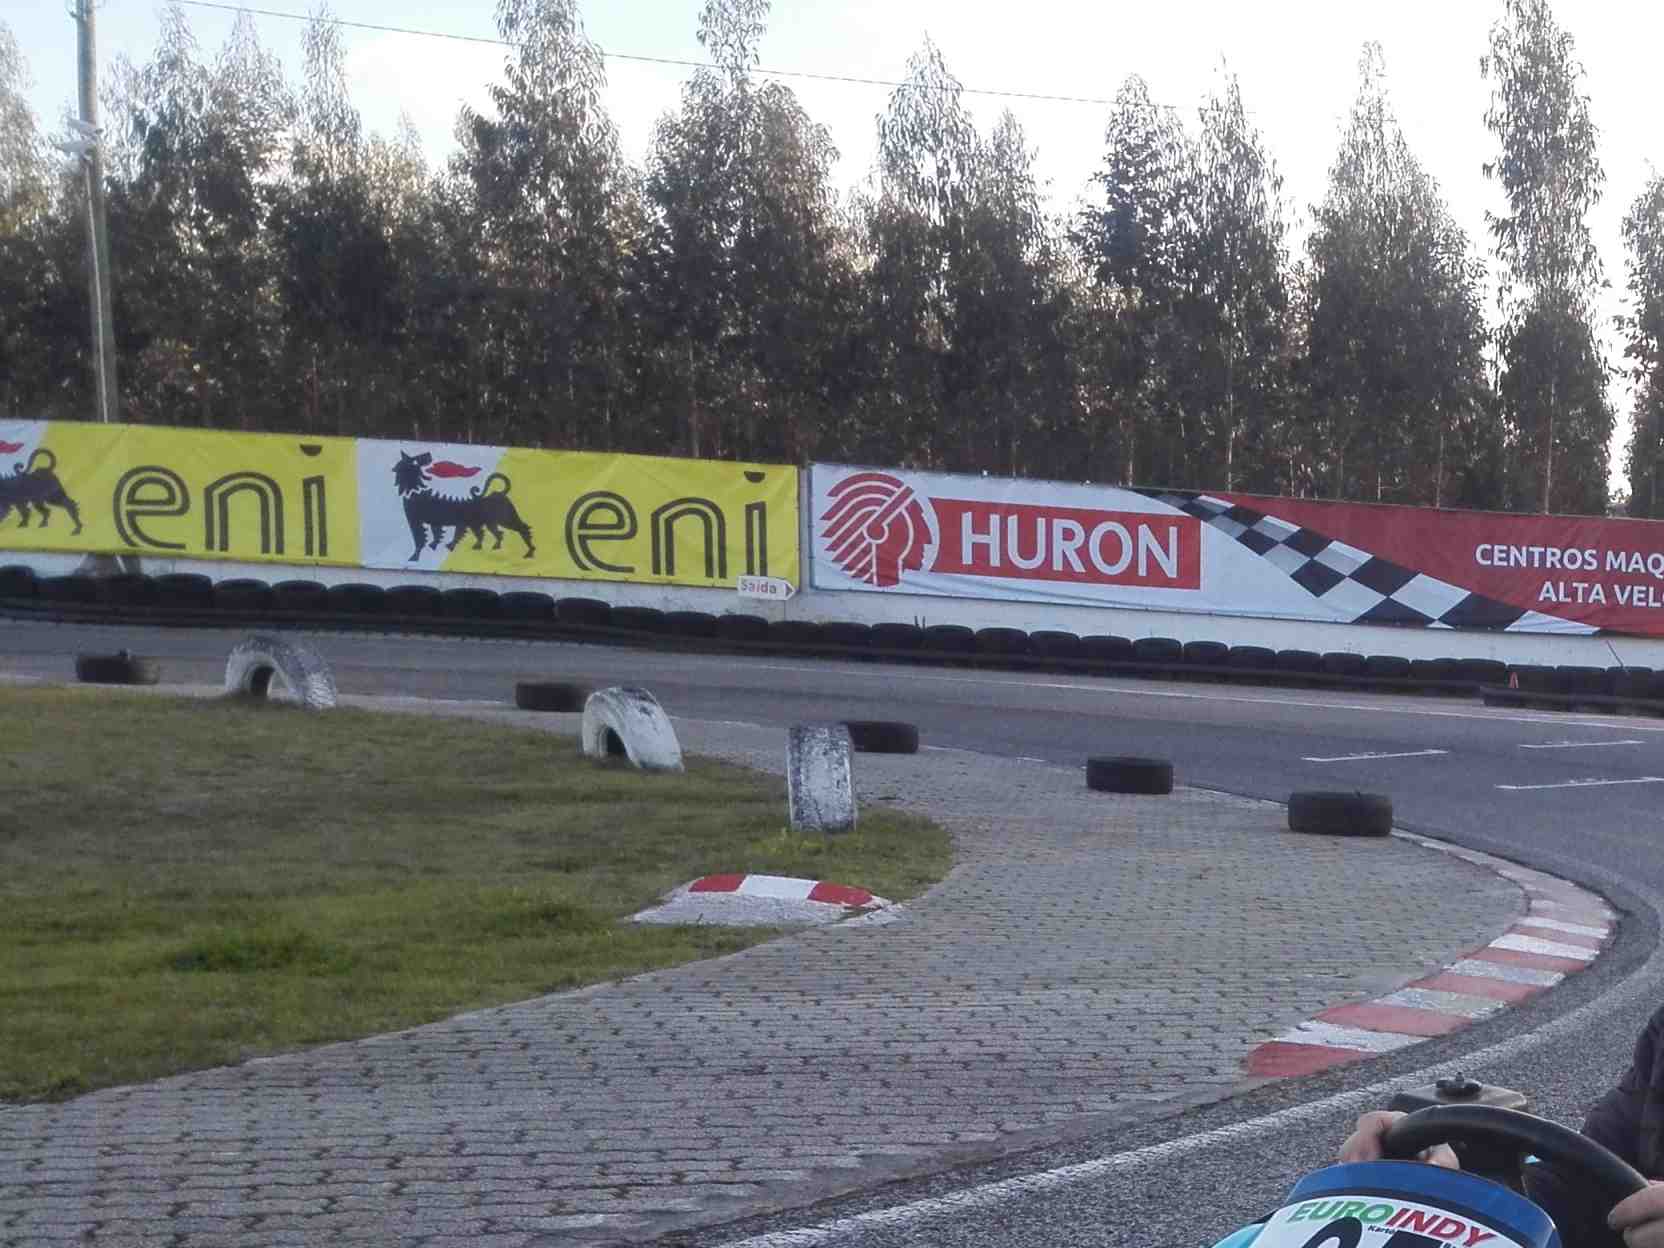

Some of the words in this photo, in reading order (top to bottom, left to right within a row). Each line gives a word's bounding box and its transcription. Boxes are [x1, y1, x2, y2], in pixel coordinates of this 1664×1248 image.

[112, 443, 328, 557] eni
[564, 470, 768, 580] eni
[961, 510, 1178, 579] HURON
[1474, 543, 1598, 572] CENTROS
[1538, 581, 1603, 605] ALTA
[1287, 1201, 1497, 1248] EUROINDY
